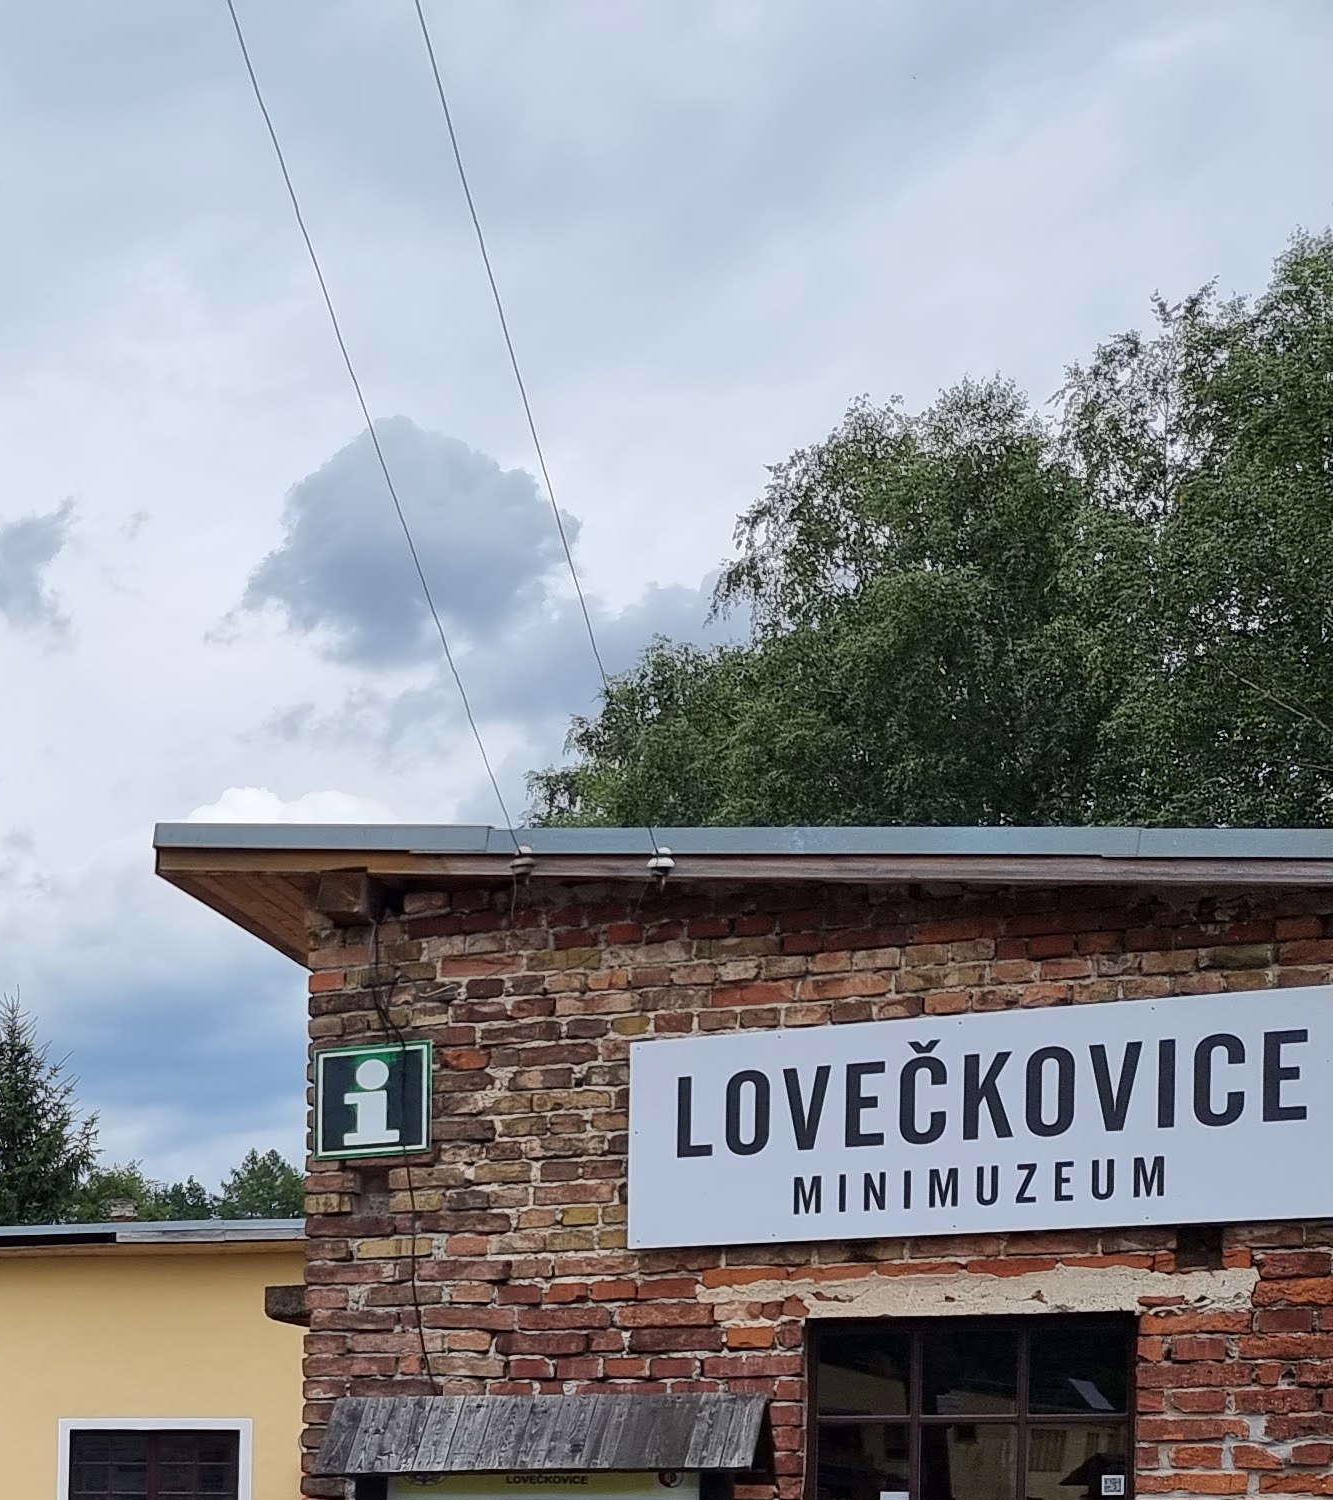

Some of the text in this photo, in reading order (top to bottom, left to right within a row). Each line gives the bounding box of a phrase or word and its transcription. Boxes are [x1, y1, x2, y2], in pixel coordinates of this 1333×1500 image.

[675, 1027, 1310, 1159] LOVEČKOVICE
[792, 1155, 1166, 1216] MINIMUZEUM
[506, 1473, 589, 1485] LOVEČKOVICE
